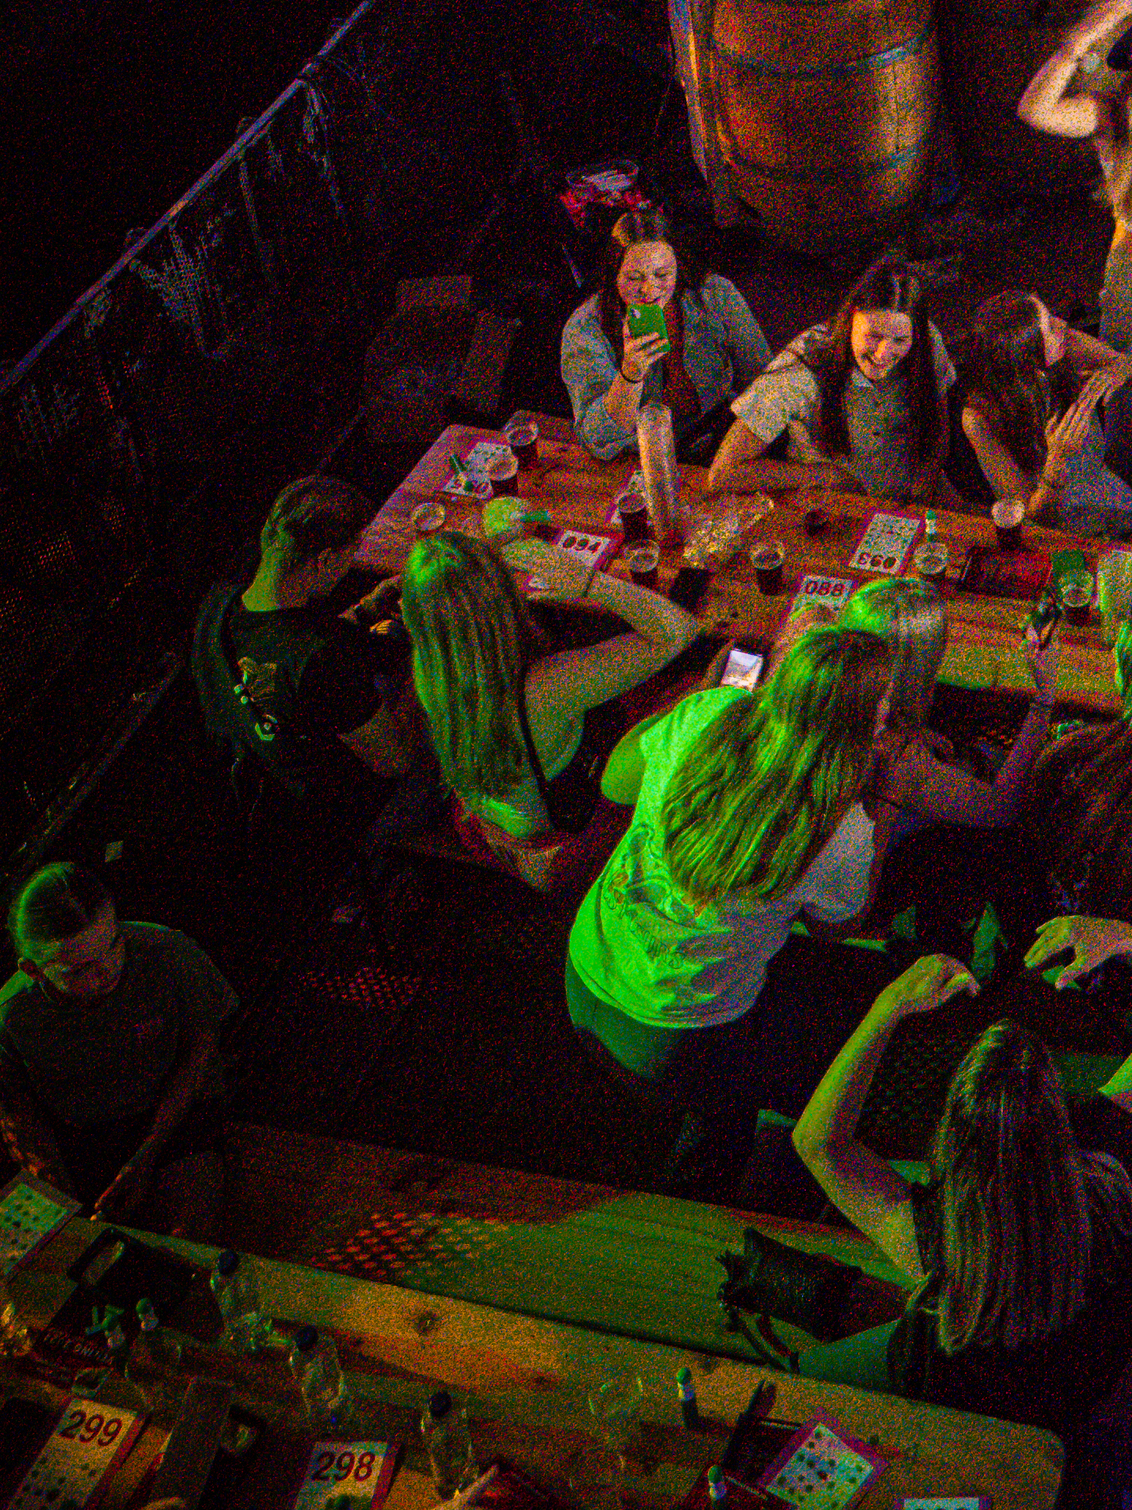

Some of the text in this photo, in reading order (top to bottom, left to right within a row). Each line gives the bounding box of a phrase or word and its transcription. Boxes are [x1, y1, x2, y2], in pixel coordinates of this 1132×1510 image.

[804, 579, 846, 597] 088
[59, 1411, 123, 1447] 299
[312, 1450, 377, 1482] 298
